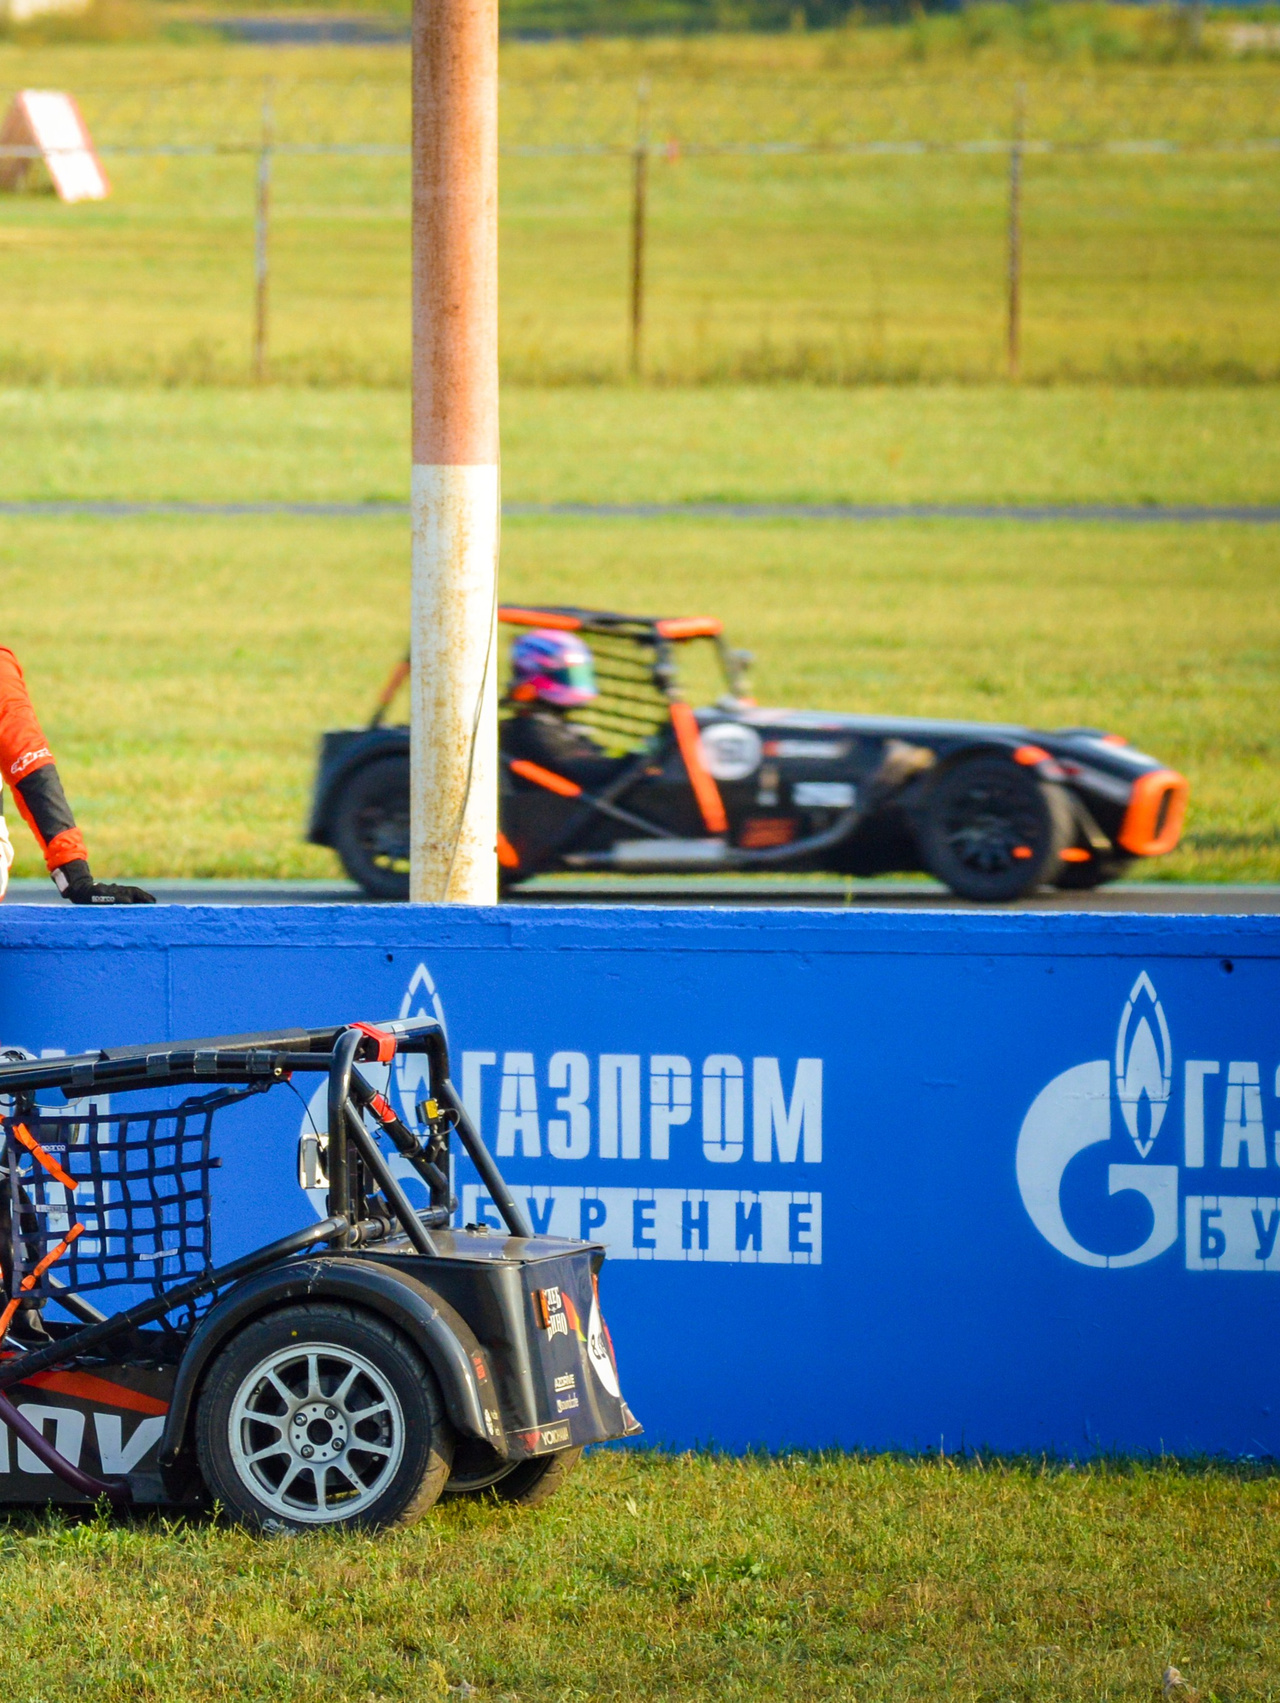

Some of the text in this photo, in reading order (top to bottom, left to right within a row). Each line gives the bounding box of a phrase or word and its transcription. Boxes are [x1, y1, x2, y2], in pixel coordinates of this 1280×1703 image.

[461, 1050, 823, 1164] ГАЗПРОМ
[1184, 1060, 1280, 1168] ГА
[475, 1196, 813, 1253] БУРЕНИЕ
